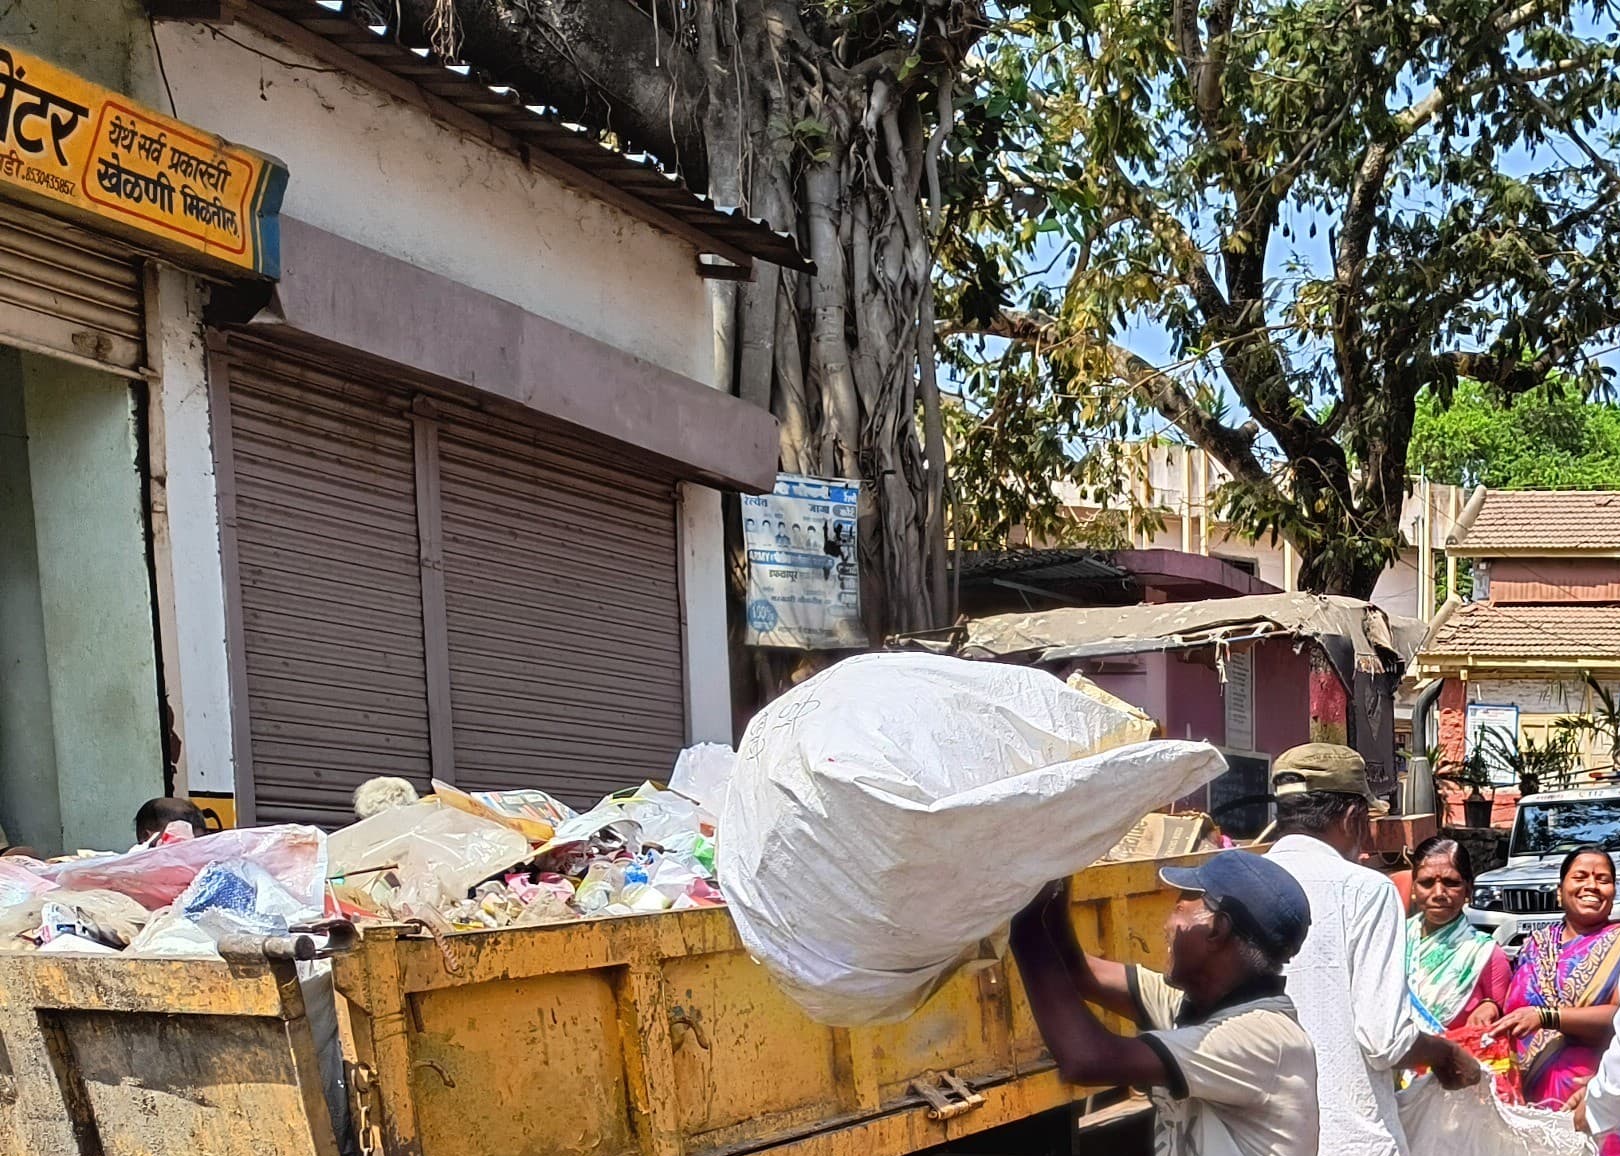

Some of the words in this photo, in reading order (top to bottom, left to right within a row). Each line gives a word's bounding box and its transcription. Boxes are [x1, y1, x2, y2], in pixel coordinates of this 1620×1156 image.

[97, 153, 175, 215] खेळणी
[109, 115, 137, 156] येथे
[137, 133, 166, 166] सर्व
[170, 146, 232, 194] प्रकारची
